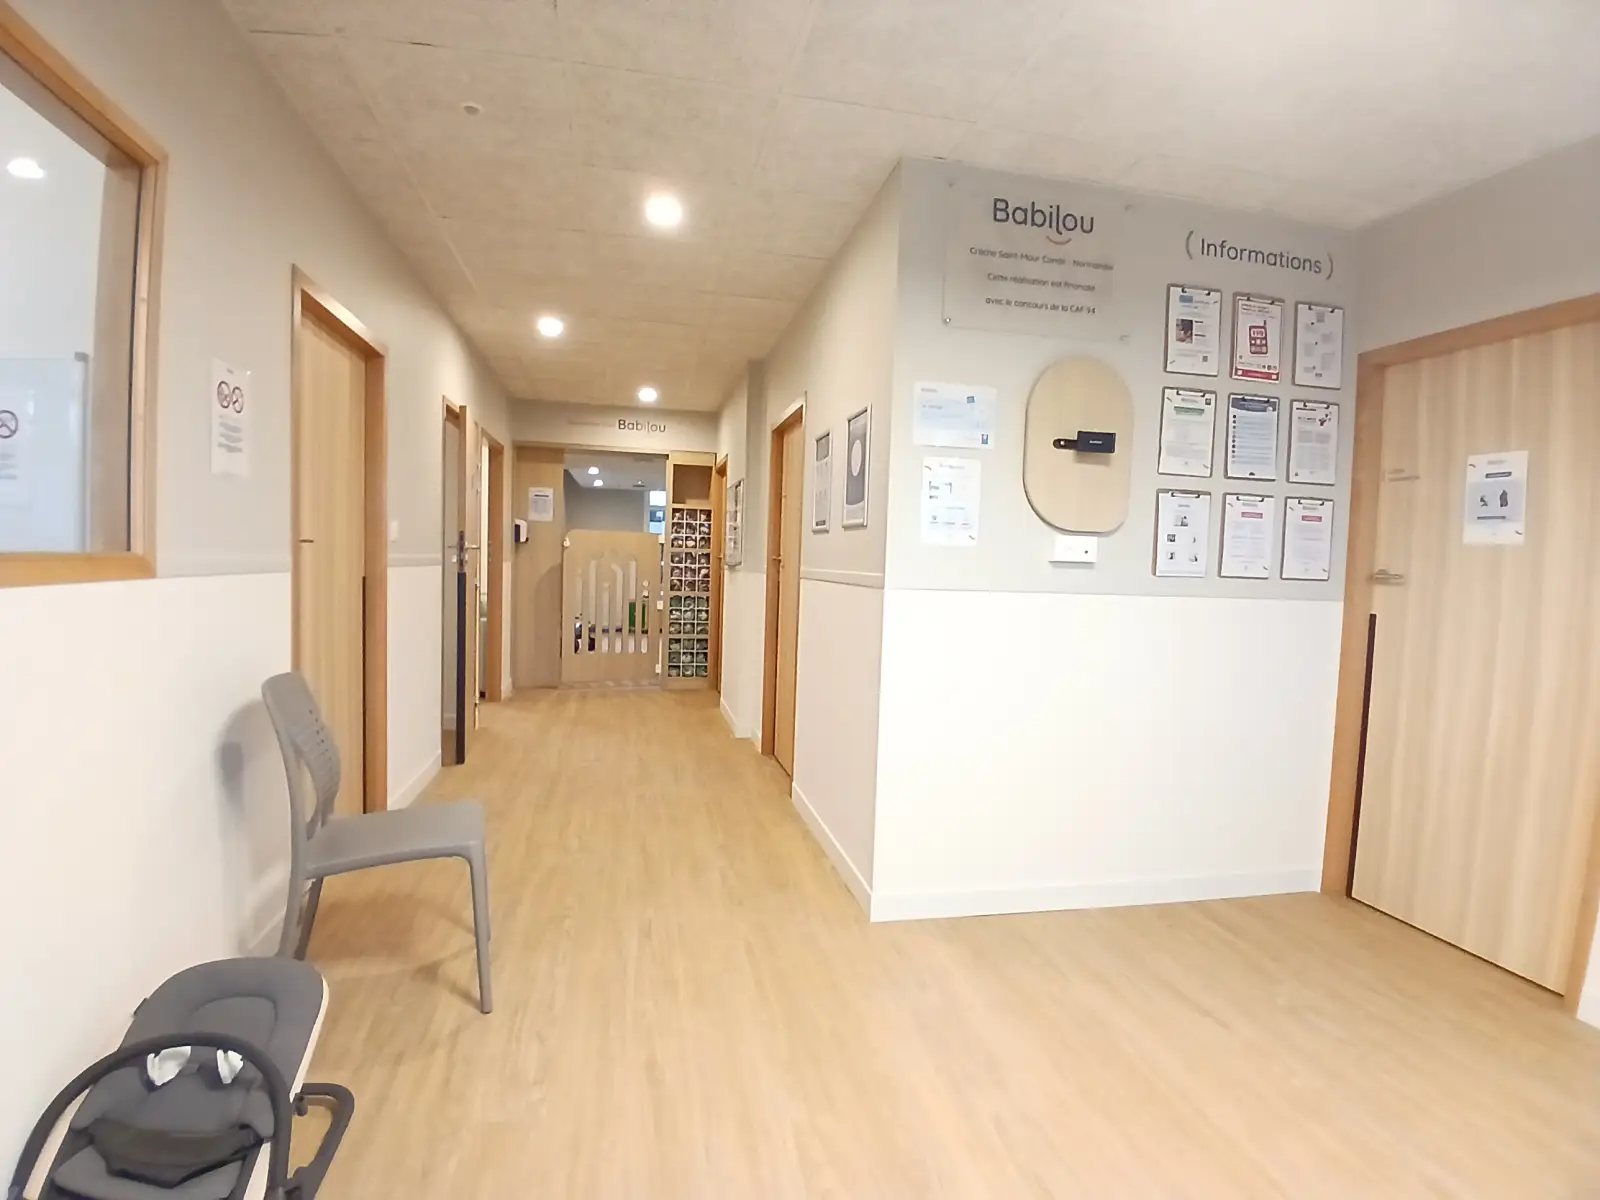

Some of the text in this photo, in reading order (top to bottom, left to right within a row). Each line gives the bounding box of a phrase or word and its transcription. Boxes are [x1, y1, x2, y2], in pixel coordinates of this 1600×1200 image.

[993, 198, 1094, 235] Babilou
[985, 297, 1004, 307] avec
[1014, 300, 1049, 311] concours
[1049, 303, 1060, 312] de
[1070, 306, 1085, 315] CAF
[618, 419, 666, 434] Babilou
